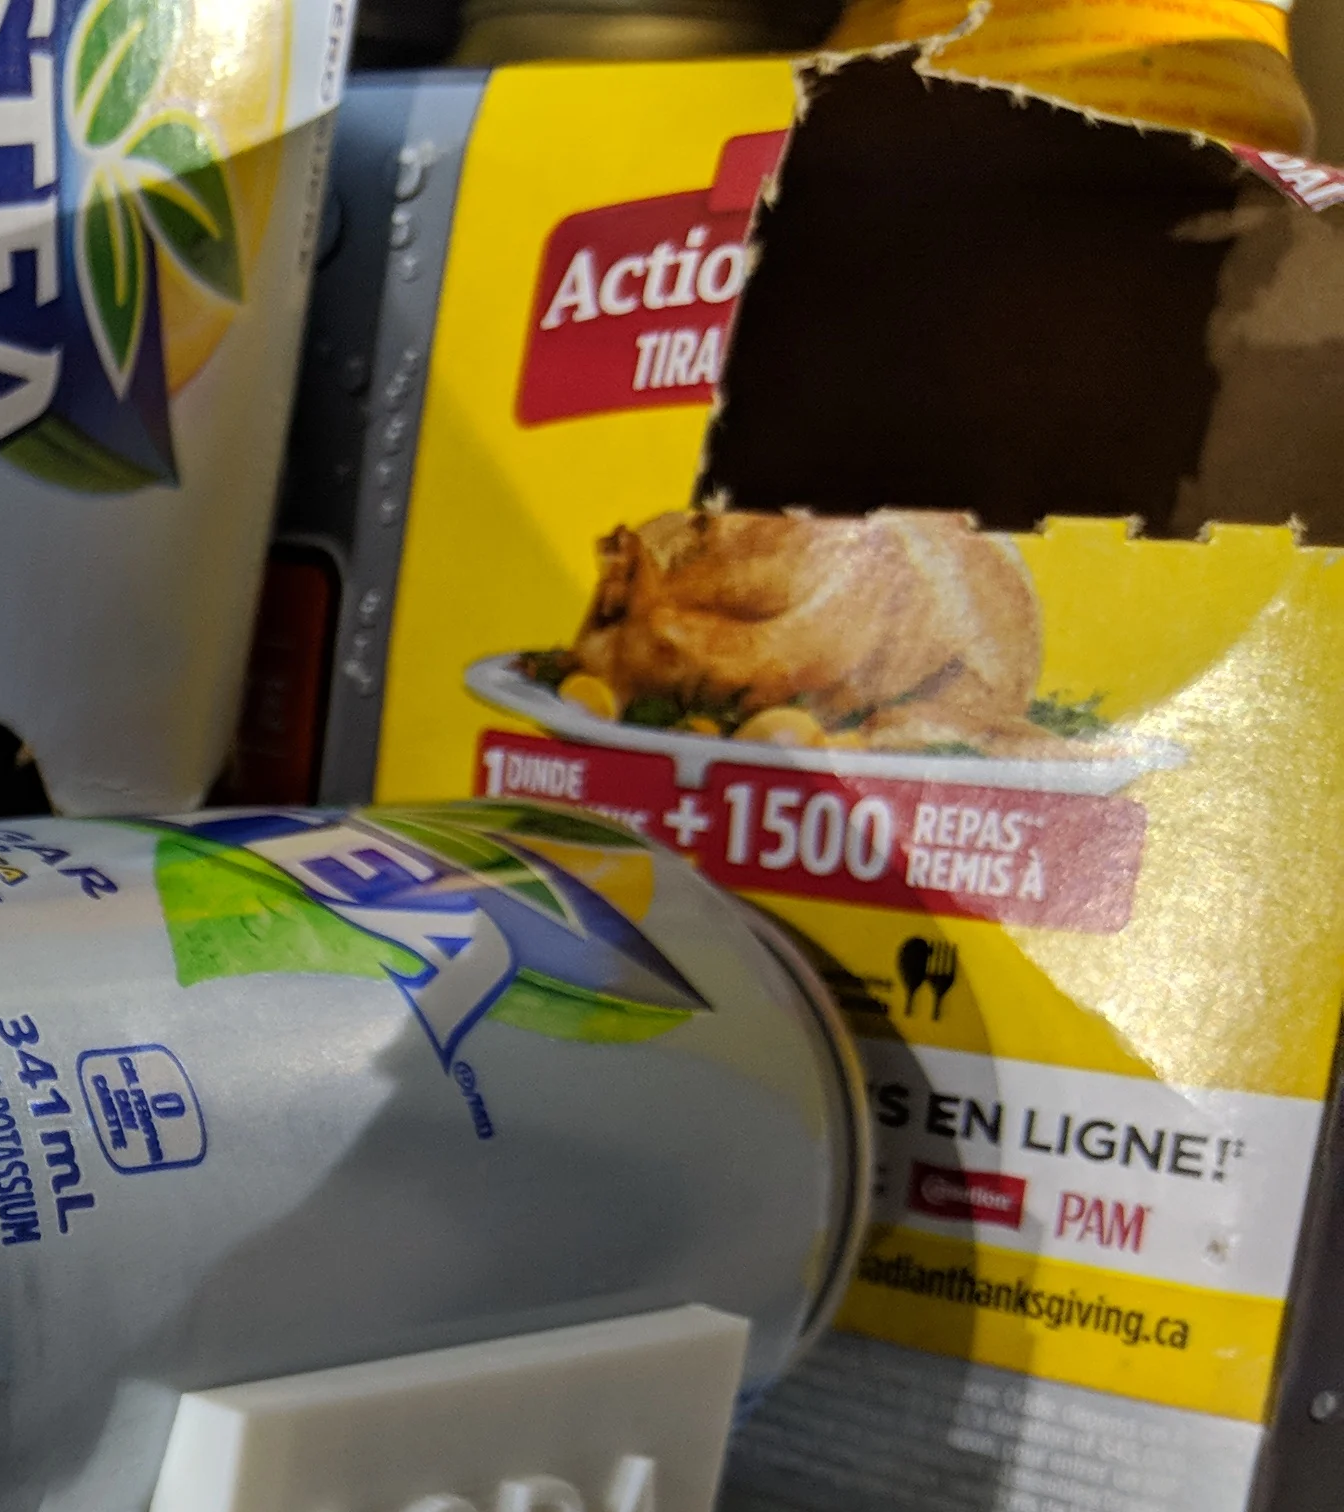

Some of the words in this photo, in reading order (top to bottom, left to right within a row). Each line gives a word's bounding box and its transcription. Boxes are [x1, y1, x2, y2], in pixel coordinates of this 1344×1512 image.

[906, 849, 1013, 897] REMIS
[868, 1081, 911, 1128] S
[924, 1092, 1003, 1146] EN
[38, 1129, 96, 1235] mL
[1054, 1190, 1146, 1254] PAM
